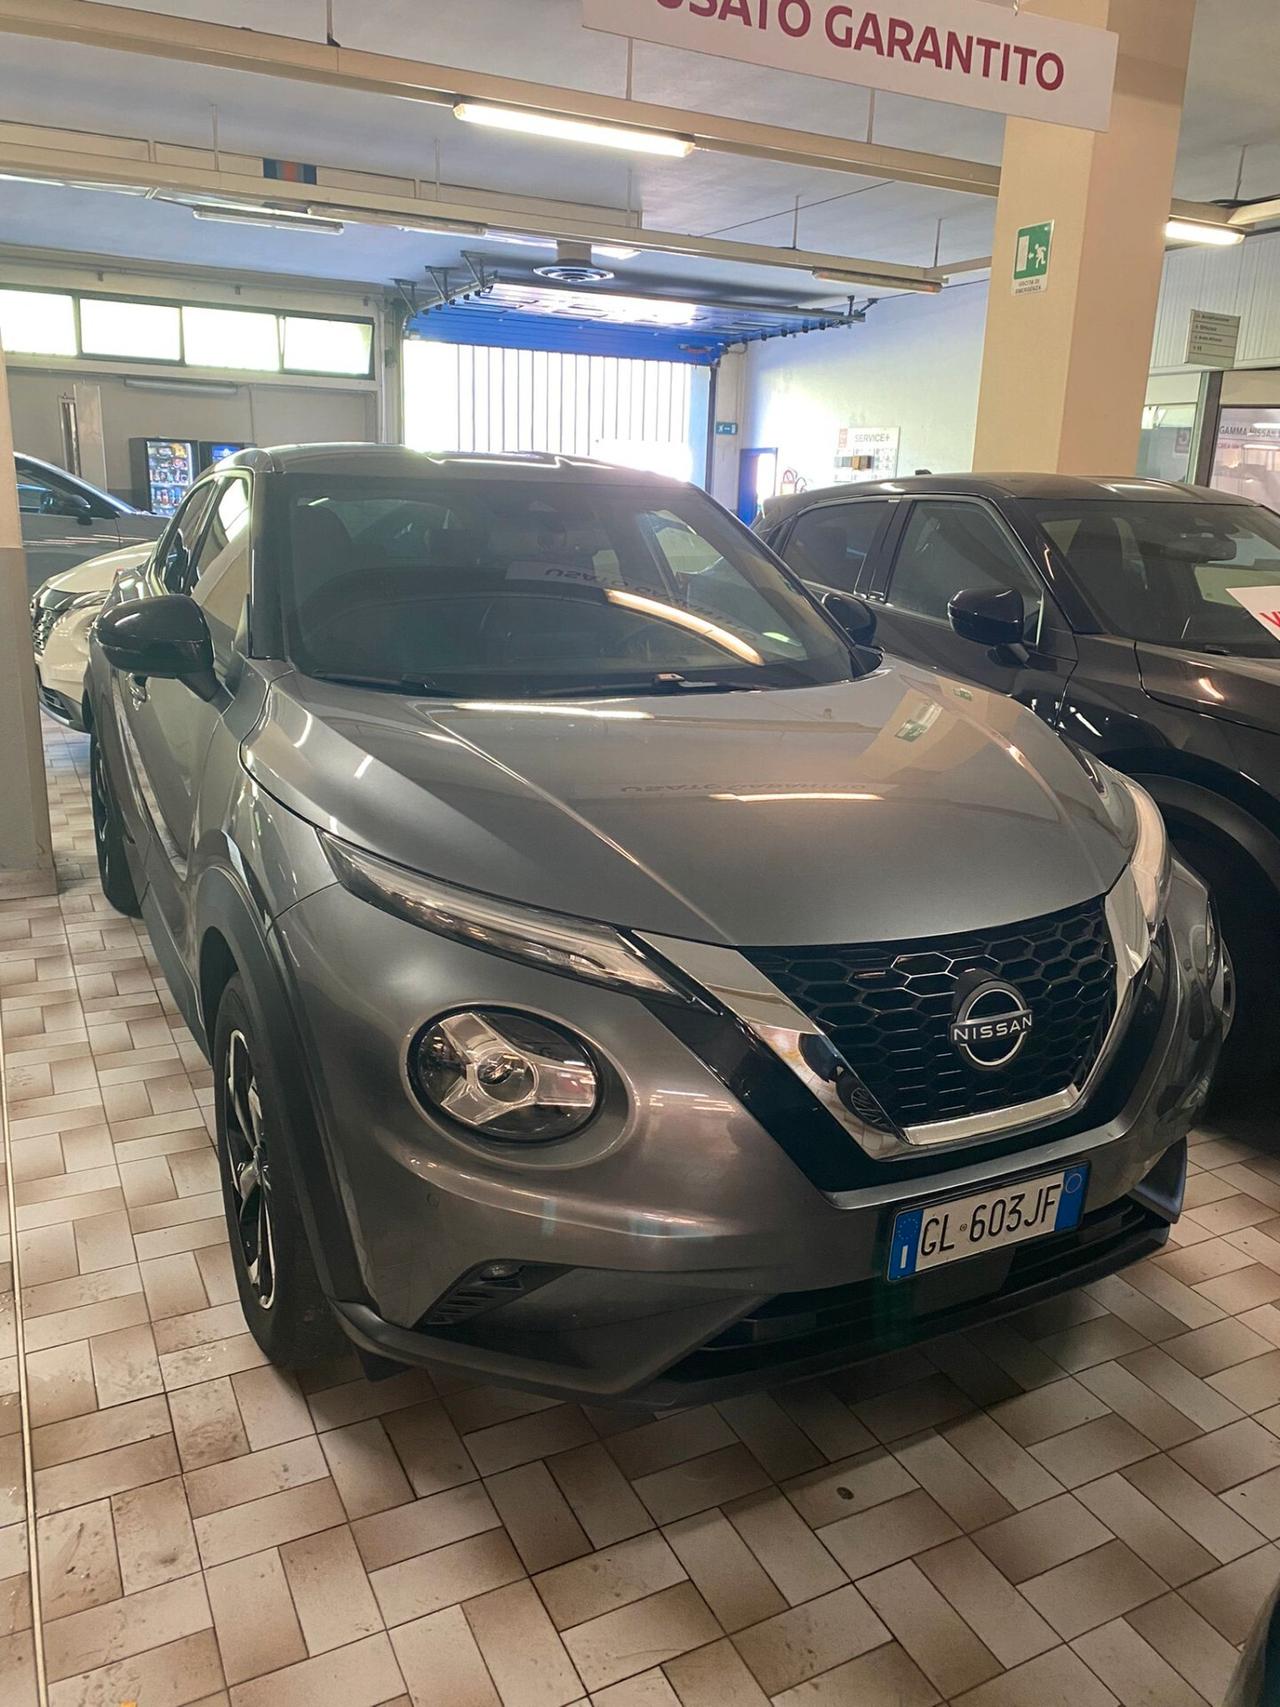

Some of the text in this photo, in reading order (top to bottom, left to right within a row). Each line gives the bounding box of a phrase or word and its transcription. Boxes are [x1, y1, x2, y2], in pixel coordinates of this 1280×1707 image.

[824, 5, 1065, 91] GARANTITO
[1219, 425, 1247, 435] GAMMA
[953, 1013, 1033, 1041] NISSAN
[920, 1216, 955, 1256] GL
